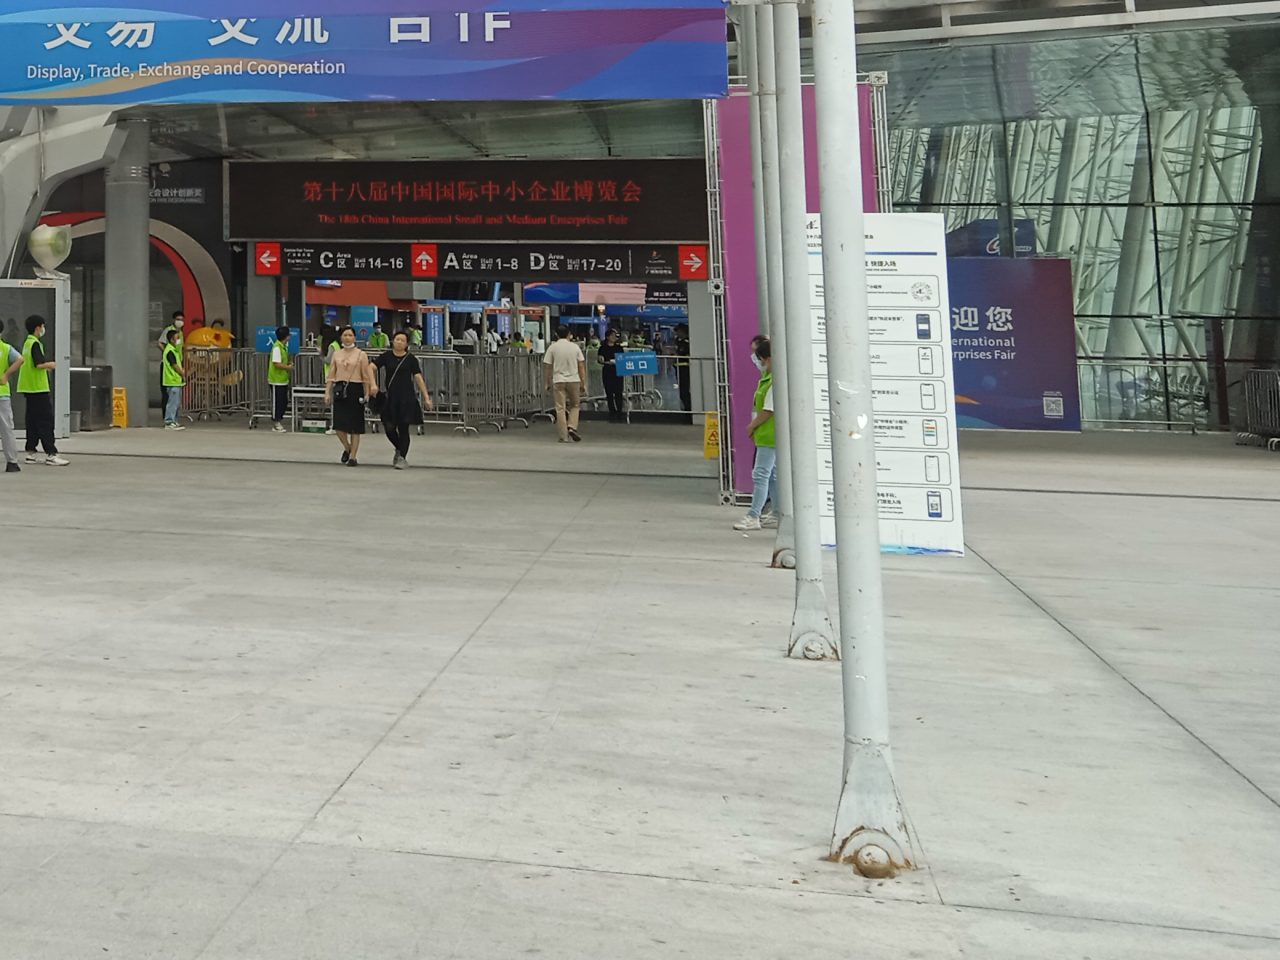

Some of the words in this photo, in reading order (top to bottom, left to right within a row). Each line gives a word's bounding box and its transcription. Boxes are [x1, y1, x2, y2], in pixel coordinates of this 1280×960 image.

[26, 63, 84, 81] Display,
[87, 63, 134, 80] Trade,
[138, 61, 210, 81] Exchange
[213, 60, 243, 76] and
[247, 59, 346, 79] Cooperation
[303, 180, 641, 203] 第十八届中国国际中小企业博览会
[361, 214, 389, 225] China
[392, 214, 452, 225] International
[455, 214, 482, 225] Small
[486, 214, 503, 225] and
[506, 214, 546, 225] Medium
[550, 214, 605, 227] Enterprises
[608, 214, 628, 225] Fair
[320, 251, 333, 268] C
[337, 258, 346, 268] 区
[369, 257, 404, 269] 14-16
[444, 252, 460, 269] A
[463, 259, 472, 269] 区
[495, 259, 518, 270] 1-8
[529, 252, 545, 270] D
[549, 260, 559, 270] 区
[581, 258, 622, 271] 17-20
[952, 306, 1014, 332] 迎您
[994, 349, 1017, 360] Fair
[625, 360, 648, 370] 出口
